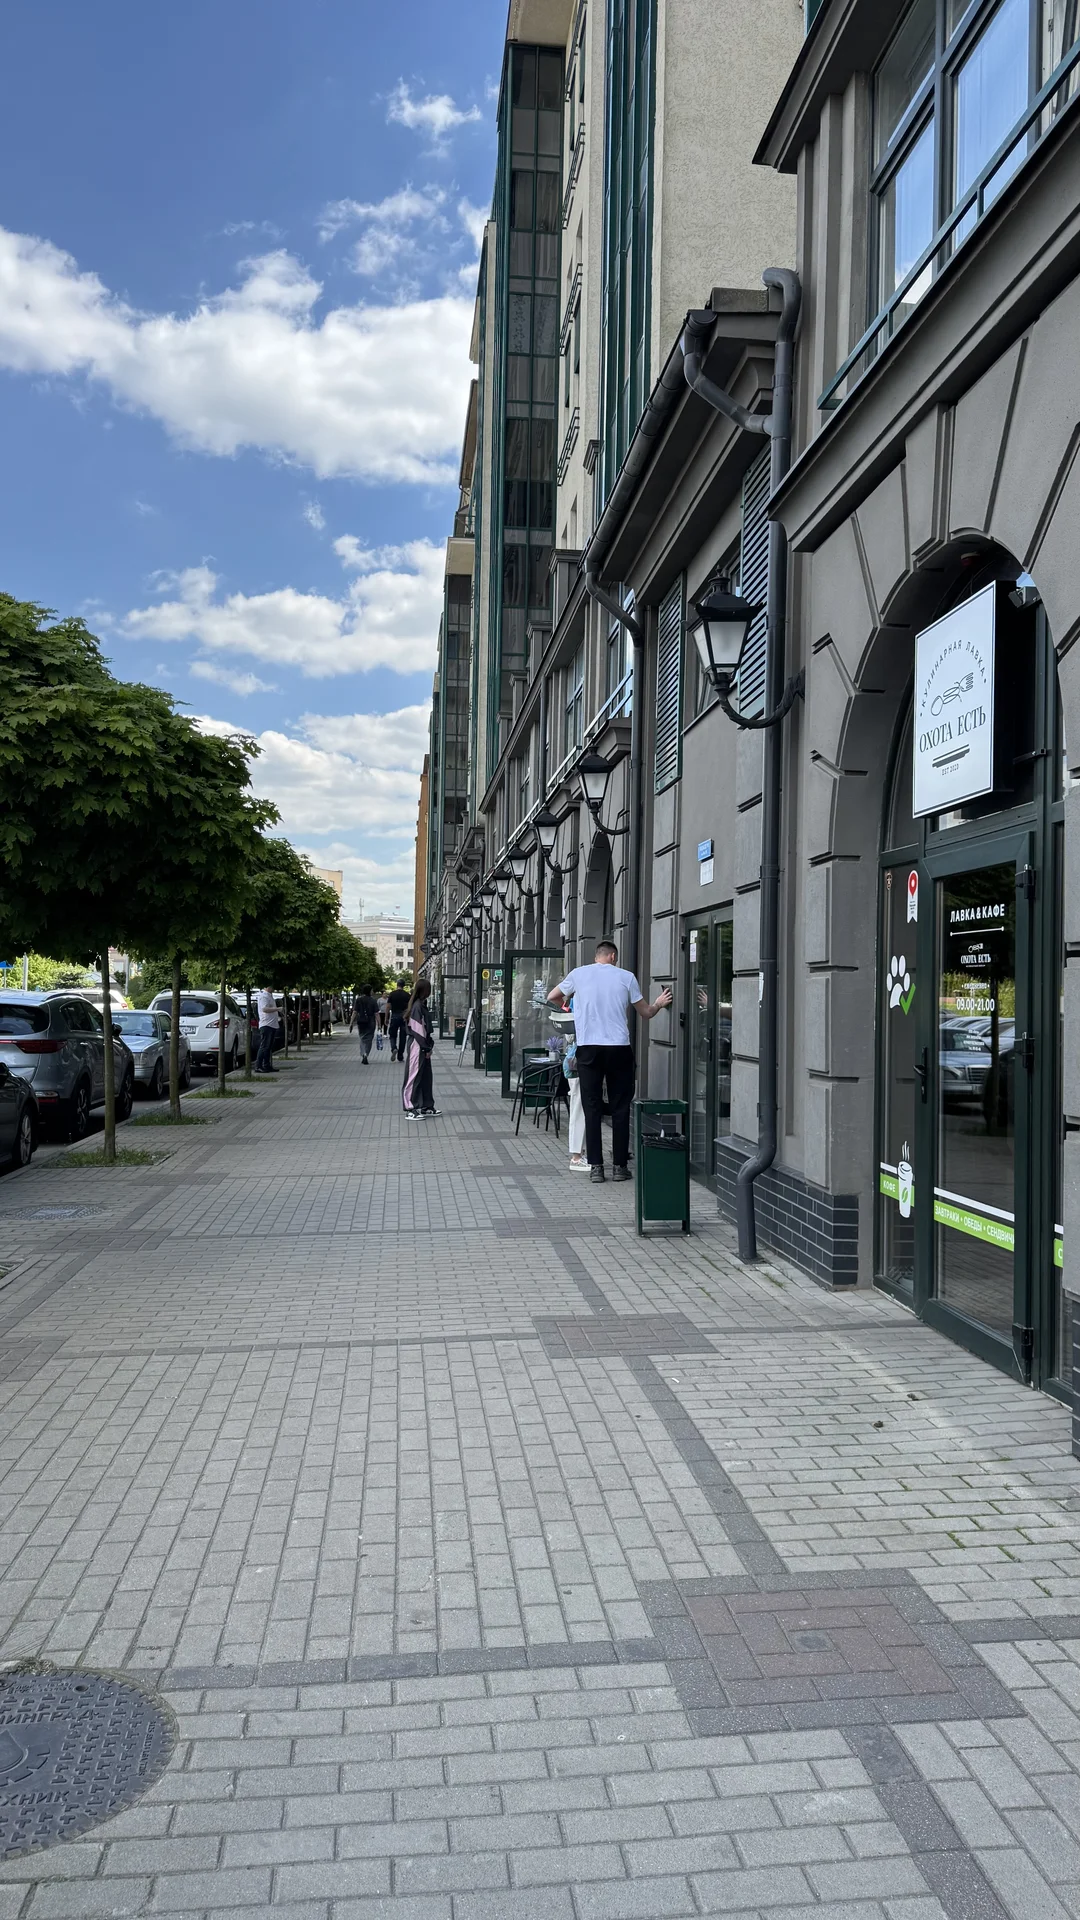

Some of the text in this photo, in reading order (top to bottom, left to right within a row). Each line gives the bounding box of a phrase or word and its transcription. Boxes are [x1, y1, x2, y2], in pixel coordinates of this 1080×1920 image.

[921, 639, 986, 707] КУЛИНАРНАЯ ЛАВКА
[919, 705, 986, 753] ОХОТА ЕСТЬ
[956, 998, 995, 1012] 09.00-21.00
[883, 1180, 896, 1193] КОФЕ
[934, 1205, 960, 1223] ЗАВТРАКИ
[963, 1216, 983, 1232] ОБЕДЫ
